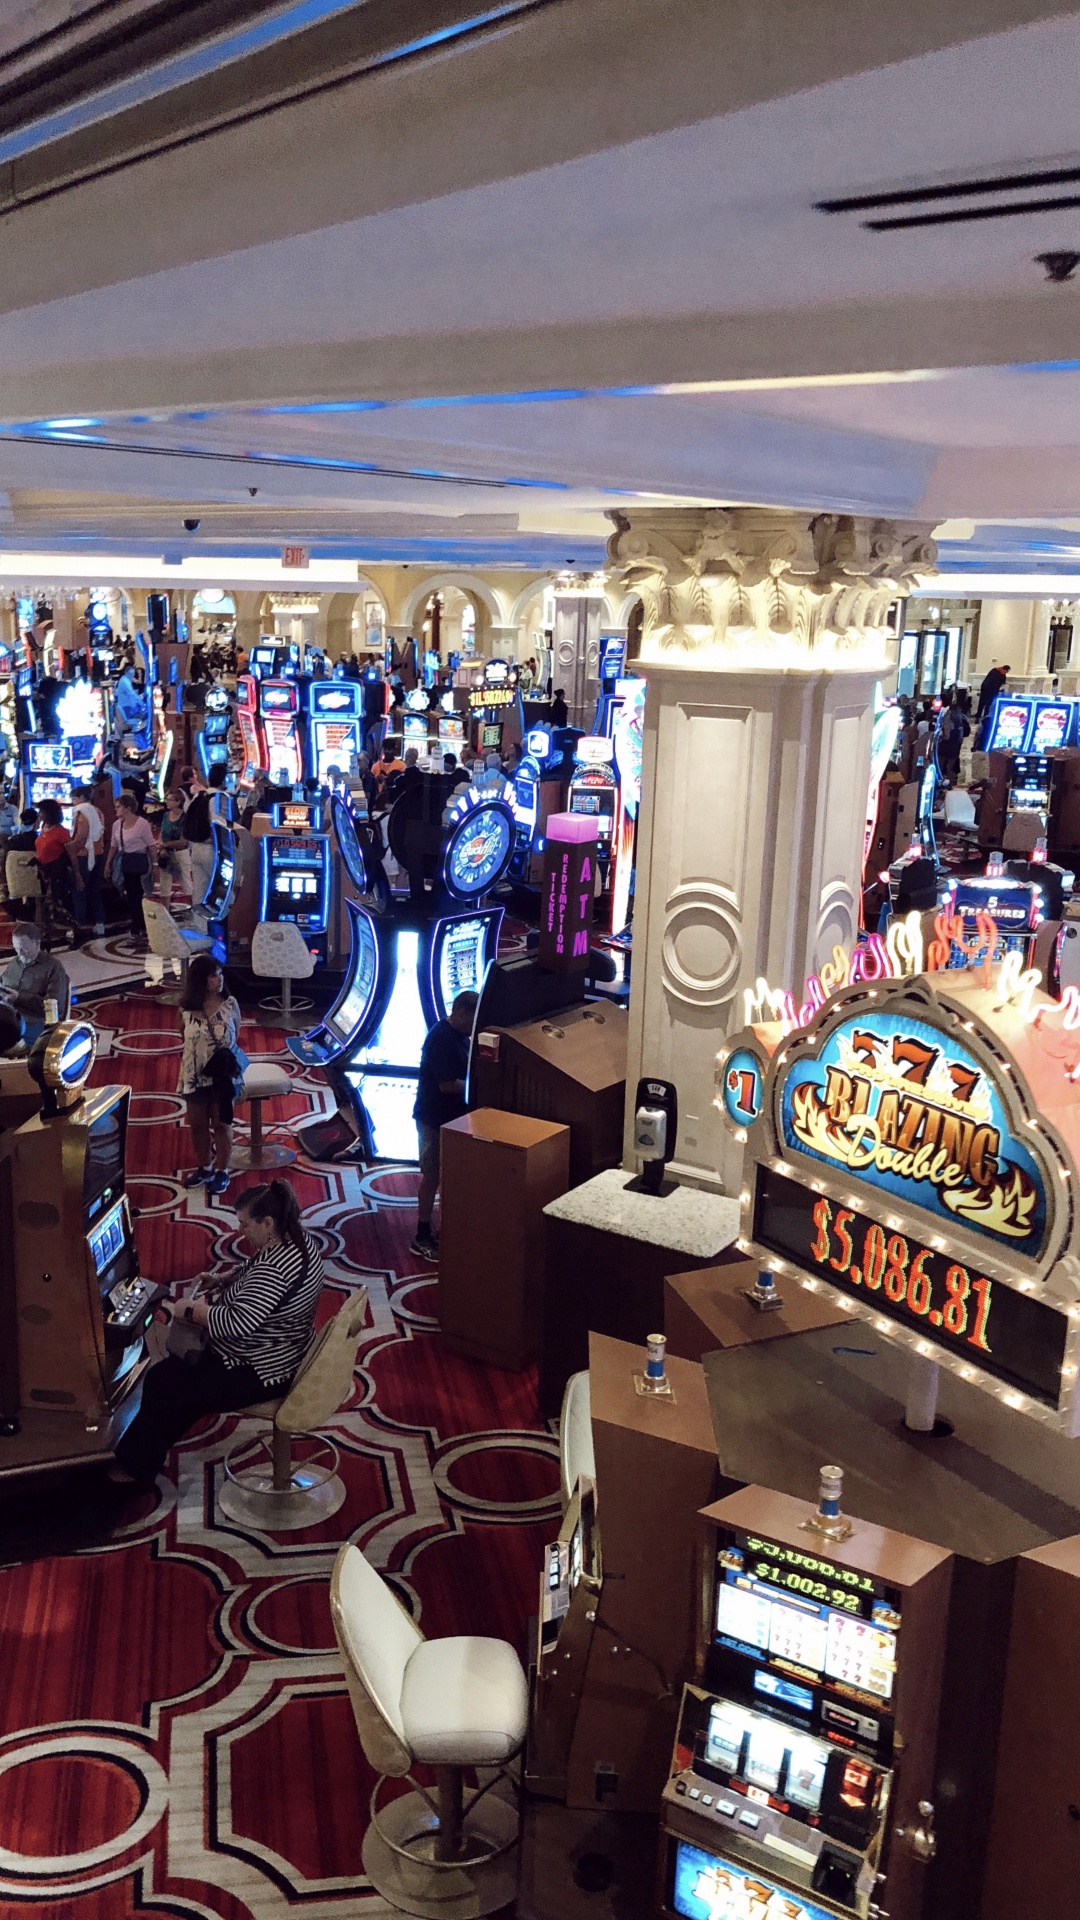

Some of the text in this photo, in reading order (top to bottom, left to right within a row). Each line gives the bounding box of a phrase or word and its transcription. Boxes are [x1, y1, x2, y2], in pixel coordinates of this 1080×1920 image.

[285, 547, 303, 565] EXIT
[548, 872, 557, 932] TICKET
[556, 853, 569, 954] REDEMPTION
[573, 857, 591, 957] ATM
[988, 896, 998, 908] 5
[729, 1069, 757, 1116] $1
[826, 1065, 1000, 1187] BLAZING
[846, 1114, 966, 1187] Double
